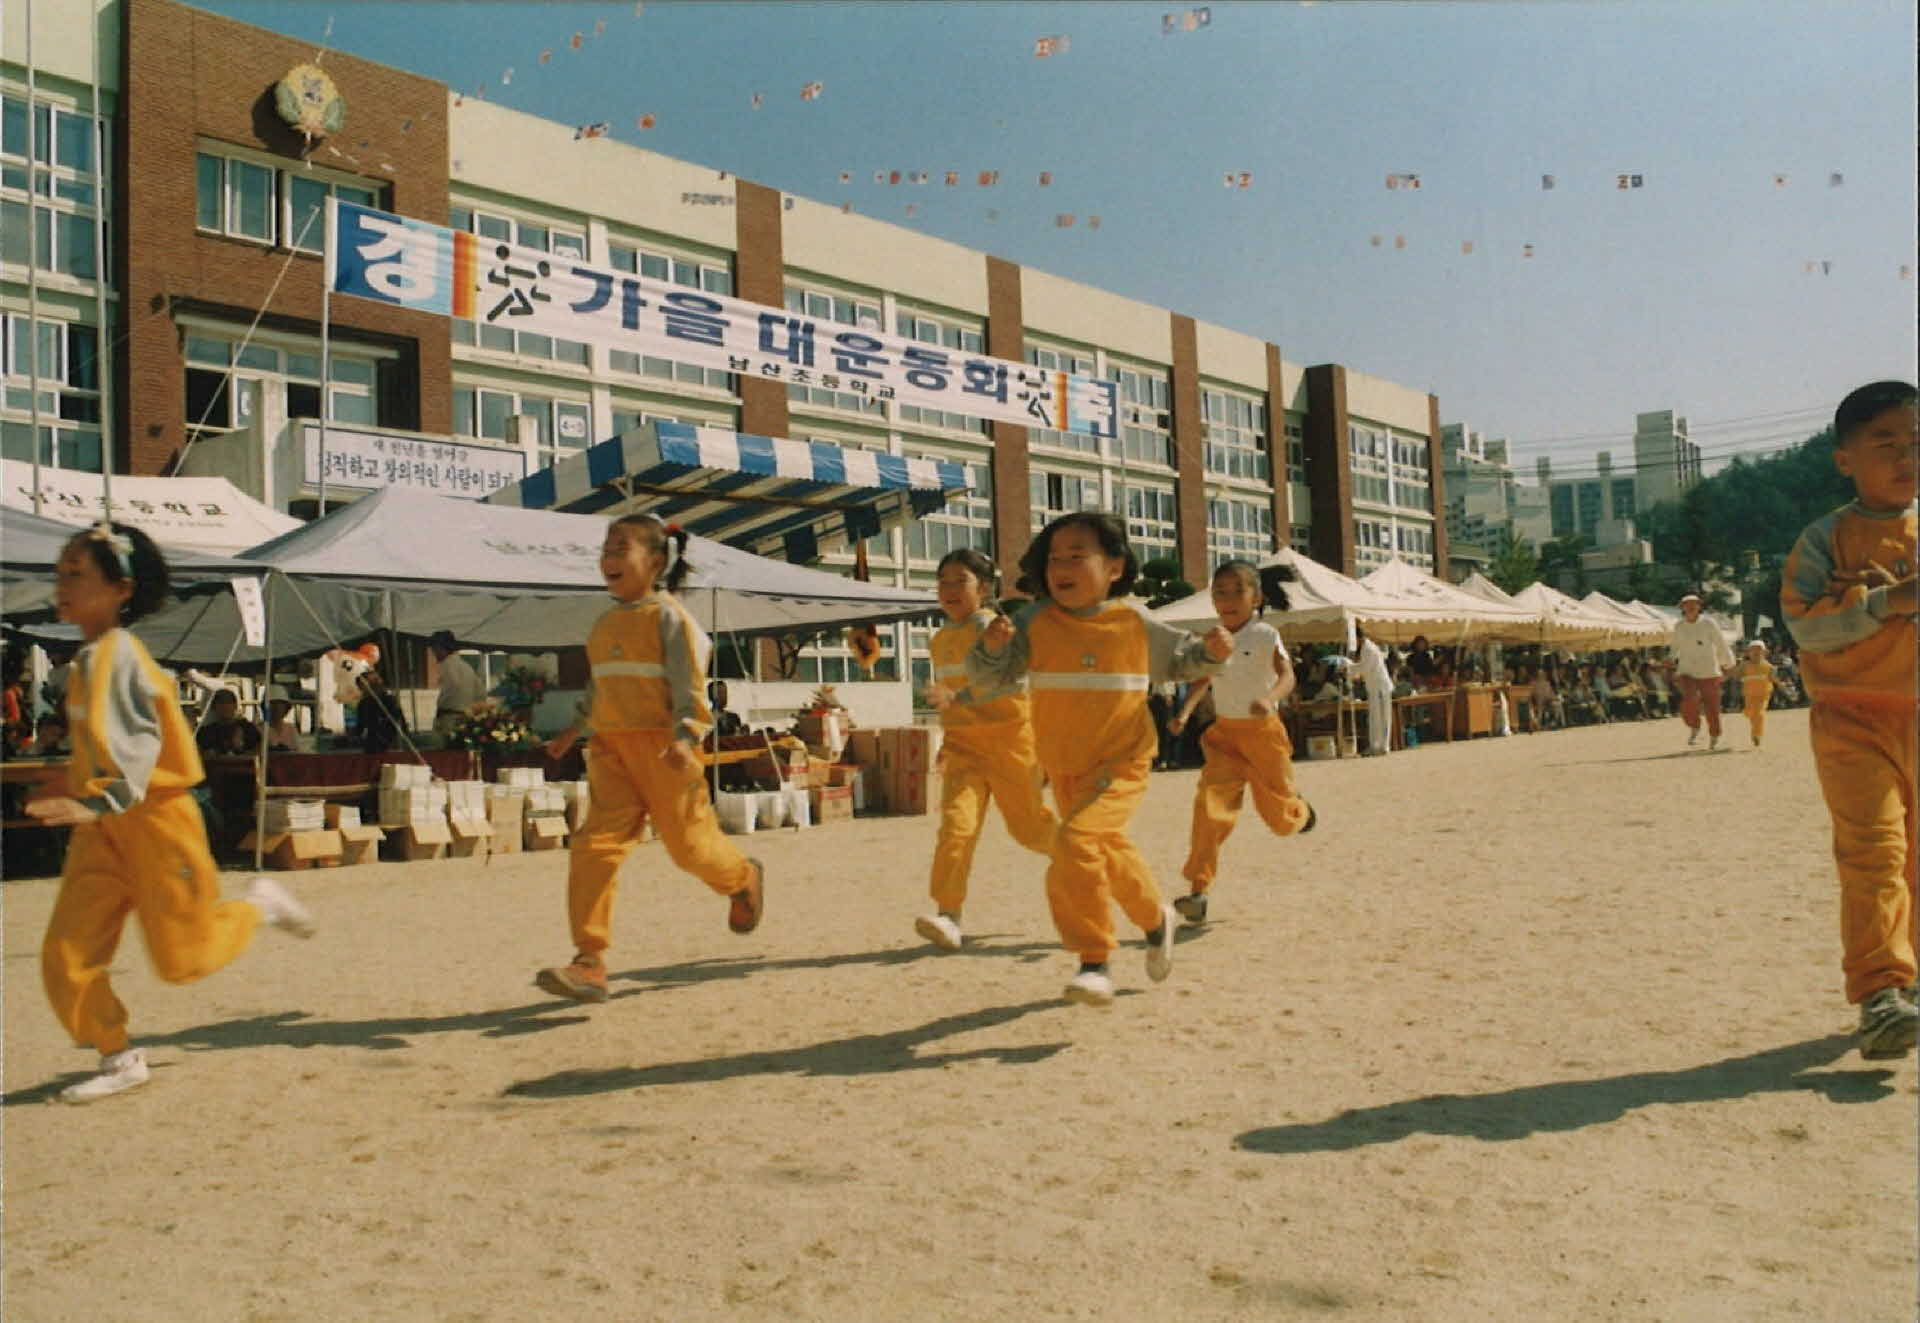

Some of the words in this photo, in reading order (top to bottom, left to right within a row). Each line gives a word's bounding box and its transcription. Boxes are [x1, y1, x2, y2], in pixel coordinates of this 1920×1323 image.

[357, 213, 439, 301] 경
[568, 266, 731, 347] 가을
[758, 311, 1008, 404] 대운동회
[728, 355, 896, 400] 남산초등학교
